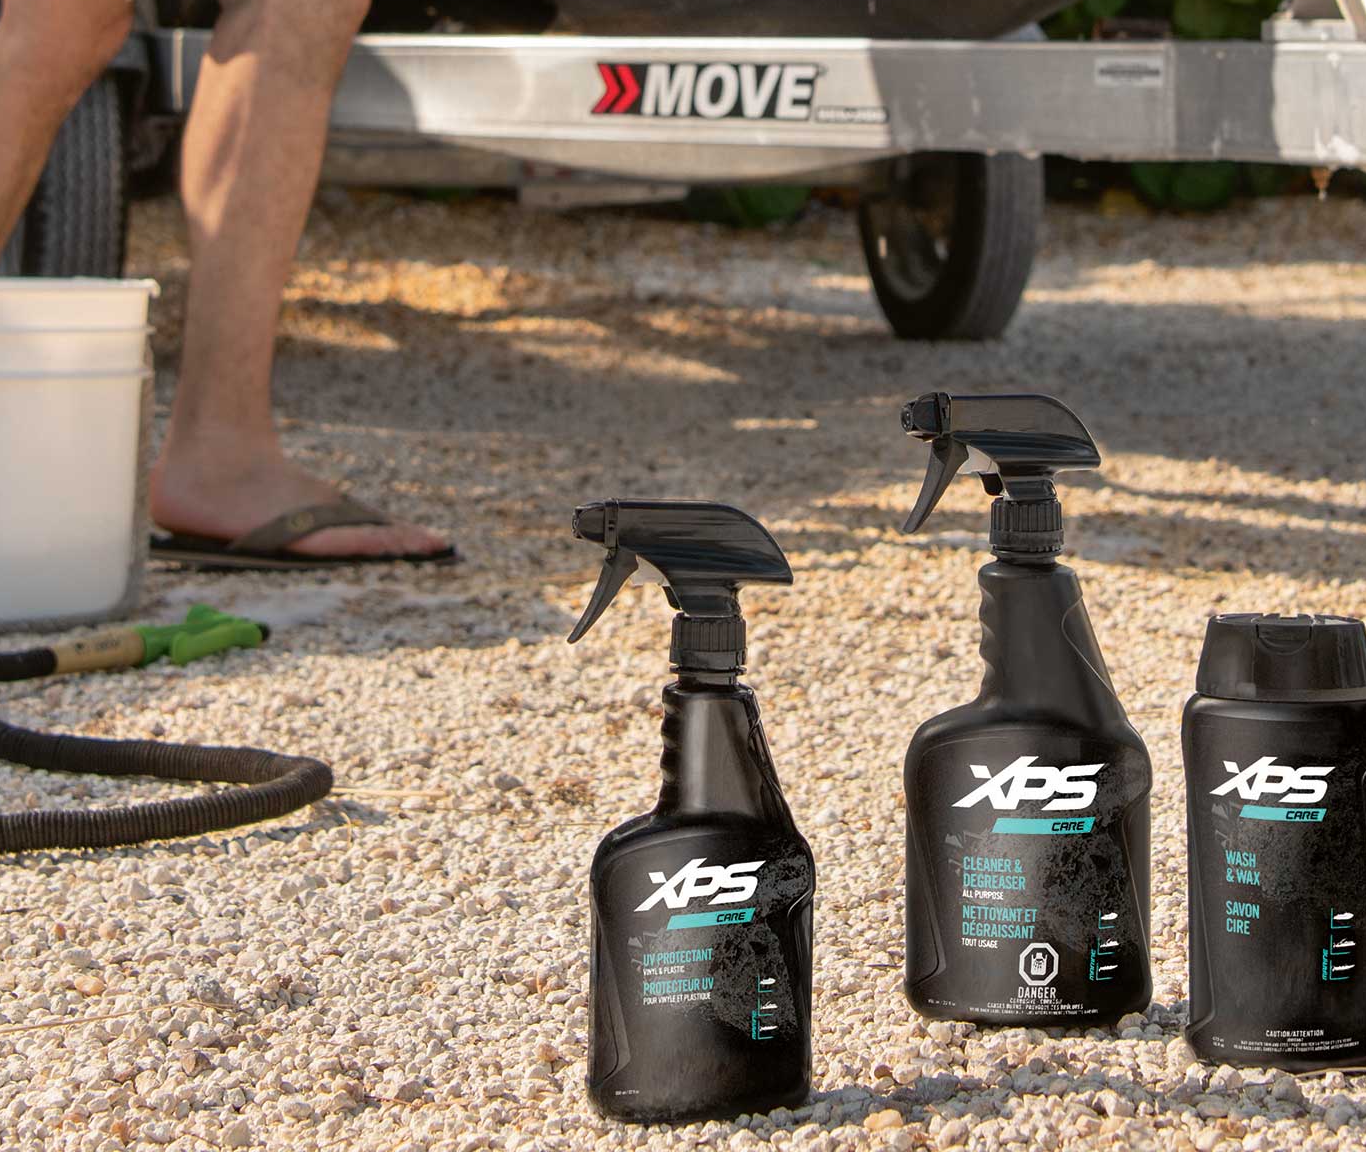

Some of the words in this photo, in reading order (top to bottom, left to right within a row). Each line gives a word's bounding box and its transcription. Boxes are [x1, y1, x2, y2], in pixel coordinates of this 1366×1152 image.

[640, 63, 818, 120] MOVE
[951, 756, 1105, 811] XPS
[1209, 756, 1336, 804] XPS
[1286, 811, 1319, 820] CARE
[1051, 821, 1085, 832] CARE
[963, 856, 1011, 873] CLEANER
[1015, 859, 1022, 873] &
[1225, 849, 1256, 868] WASH
[634, 857, 766, 912] XPS
[963, 873, 1025, 890] DEGREASER
[1226, 867, 1234, 883] &
[1237, 869, 1260, 886] WAX
[962, 889, 973, 898] ALL
[974, 890, 1004, 900] PURPOSE
[717, 912, 746, 923] CARE
[962, 905, 1022, 922] NETTOYANT
[1025, 909, 1037, 922] ET
[1226, 900, 1260, 919] SAVON
[962, 920, 1035, 939] DÉGRAISSANT
[1226, 918, 1250, 935] CIRE
[962, 938, 977, 947] TOUT
[978, 940, 998, 949] USAGE
[643, 953, 655, 966] UV
[657, 948, 713, 965] PROTECTANT
[664, 965, 685, 974] PLASTIC
[643, 978, 700, 995] PROTECTEUR
[702, 977, 714, 990] UV
[1018, 987, 1056, 999] DANGER
[643, 996, 657, 1005] POUR
[658, 995, 676, 1003] VINYLE
[676, 994, 683, 1002] ET
[684, 992, 711, 1001] PLASTIQUE
